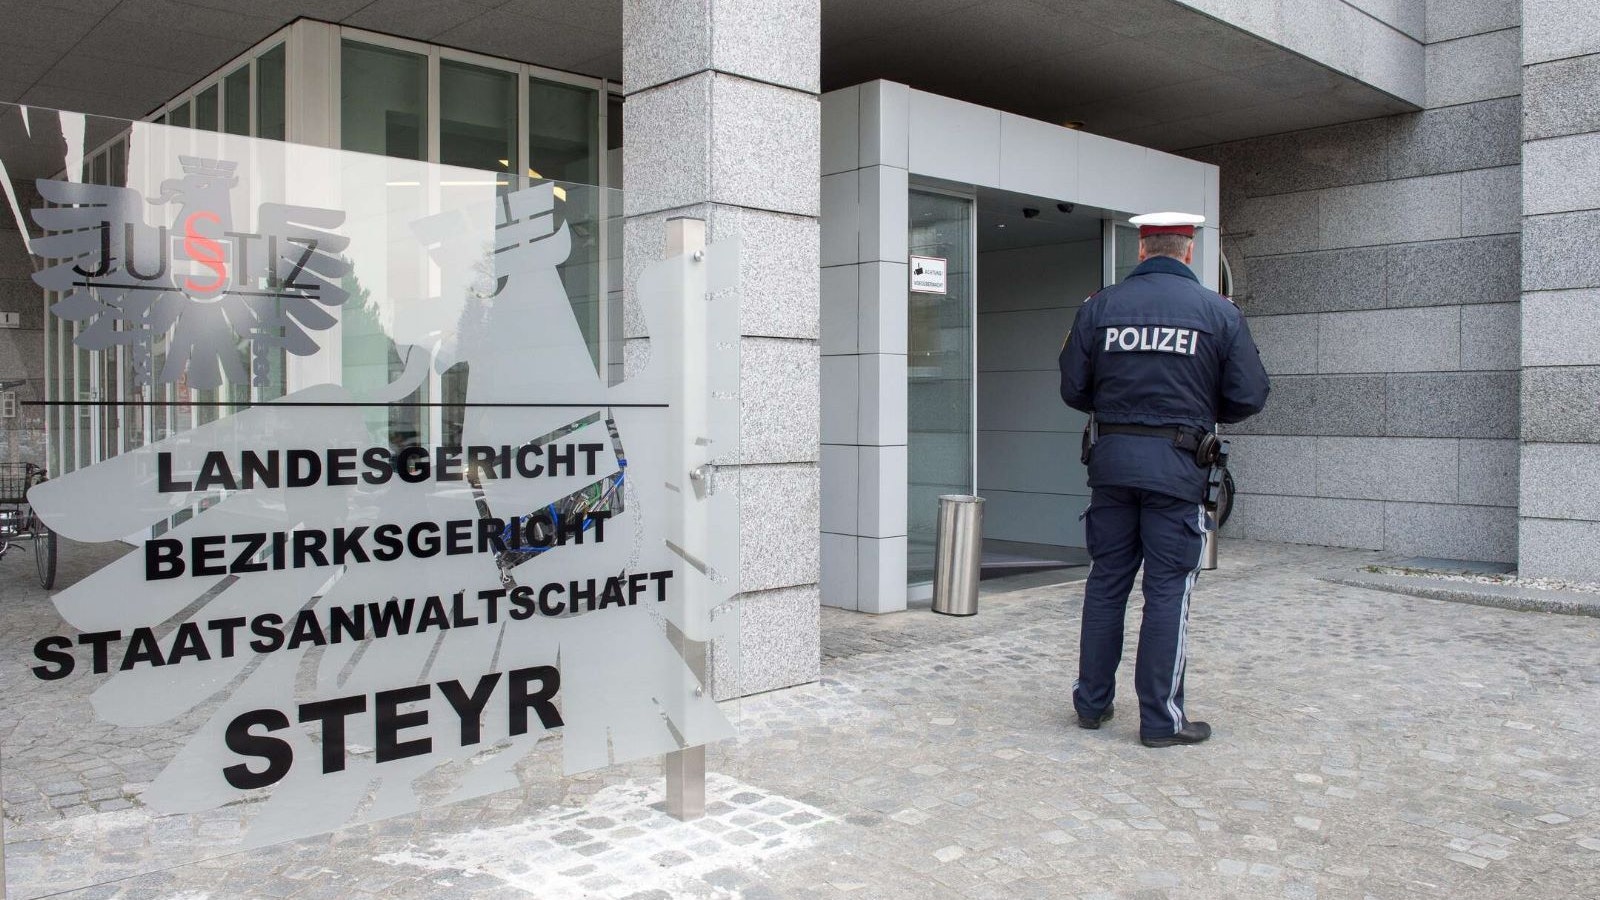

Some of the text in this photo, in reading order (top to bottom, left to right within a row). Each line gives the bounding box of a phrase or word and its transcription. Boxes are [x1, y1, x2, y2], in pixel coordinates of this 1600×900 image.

[1104, 327, 1198, 355] POLIZEI
[157, 442, 604, 493] LANDESGERICHT
[145, 511, 612, 581] BEZIRKSGERICHT
[32, 570, 674, 680] STAATSANWALTSCHAFT
[222, 664, 565, 790] STEYR
